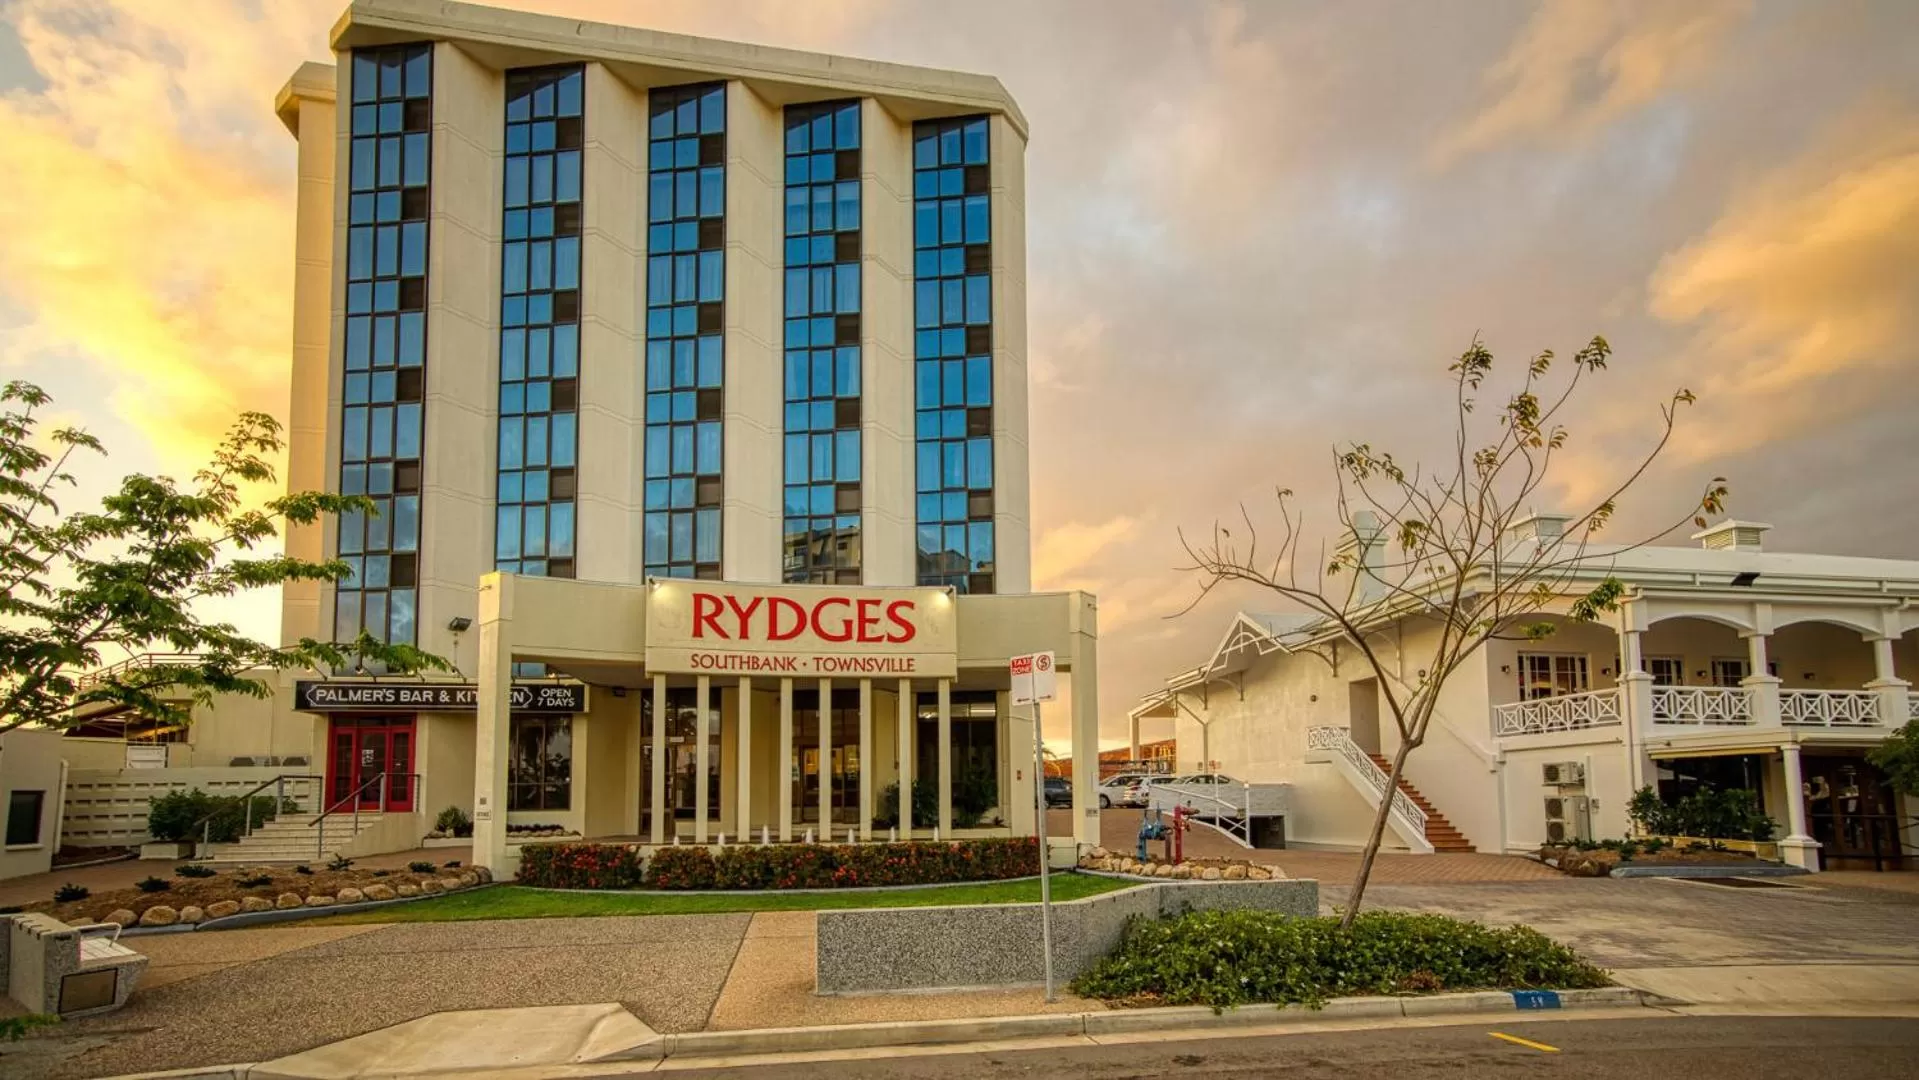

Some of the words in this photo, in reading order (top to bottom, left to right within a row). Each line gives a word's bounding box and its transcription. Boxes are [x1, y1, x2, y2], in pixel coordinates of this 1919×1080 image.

[692, 593, 916, 643] RYDGES
[691, 653, 798, 672] SOUTHBANK
[812, 656, 916, 673] TOWNSVILLE
[315, 688, 396, 703] PALMER'S
[400, 690, 434, 703] BAR
[439, 690, 451, 703] &
[541, 688, 572, 698] OPEN
[537, 697, 544, 707] 7
[546, 697, 576, 707] DAYS
